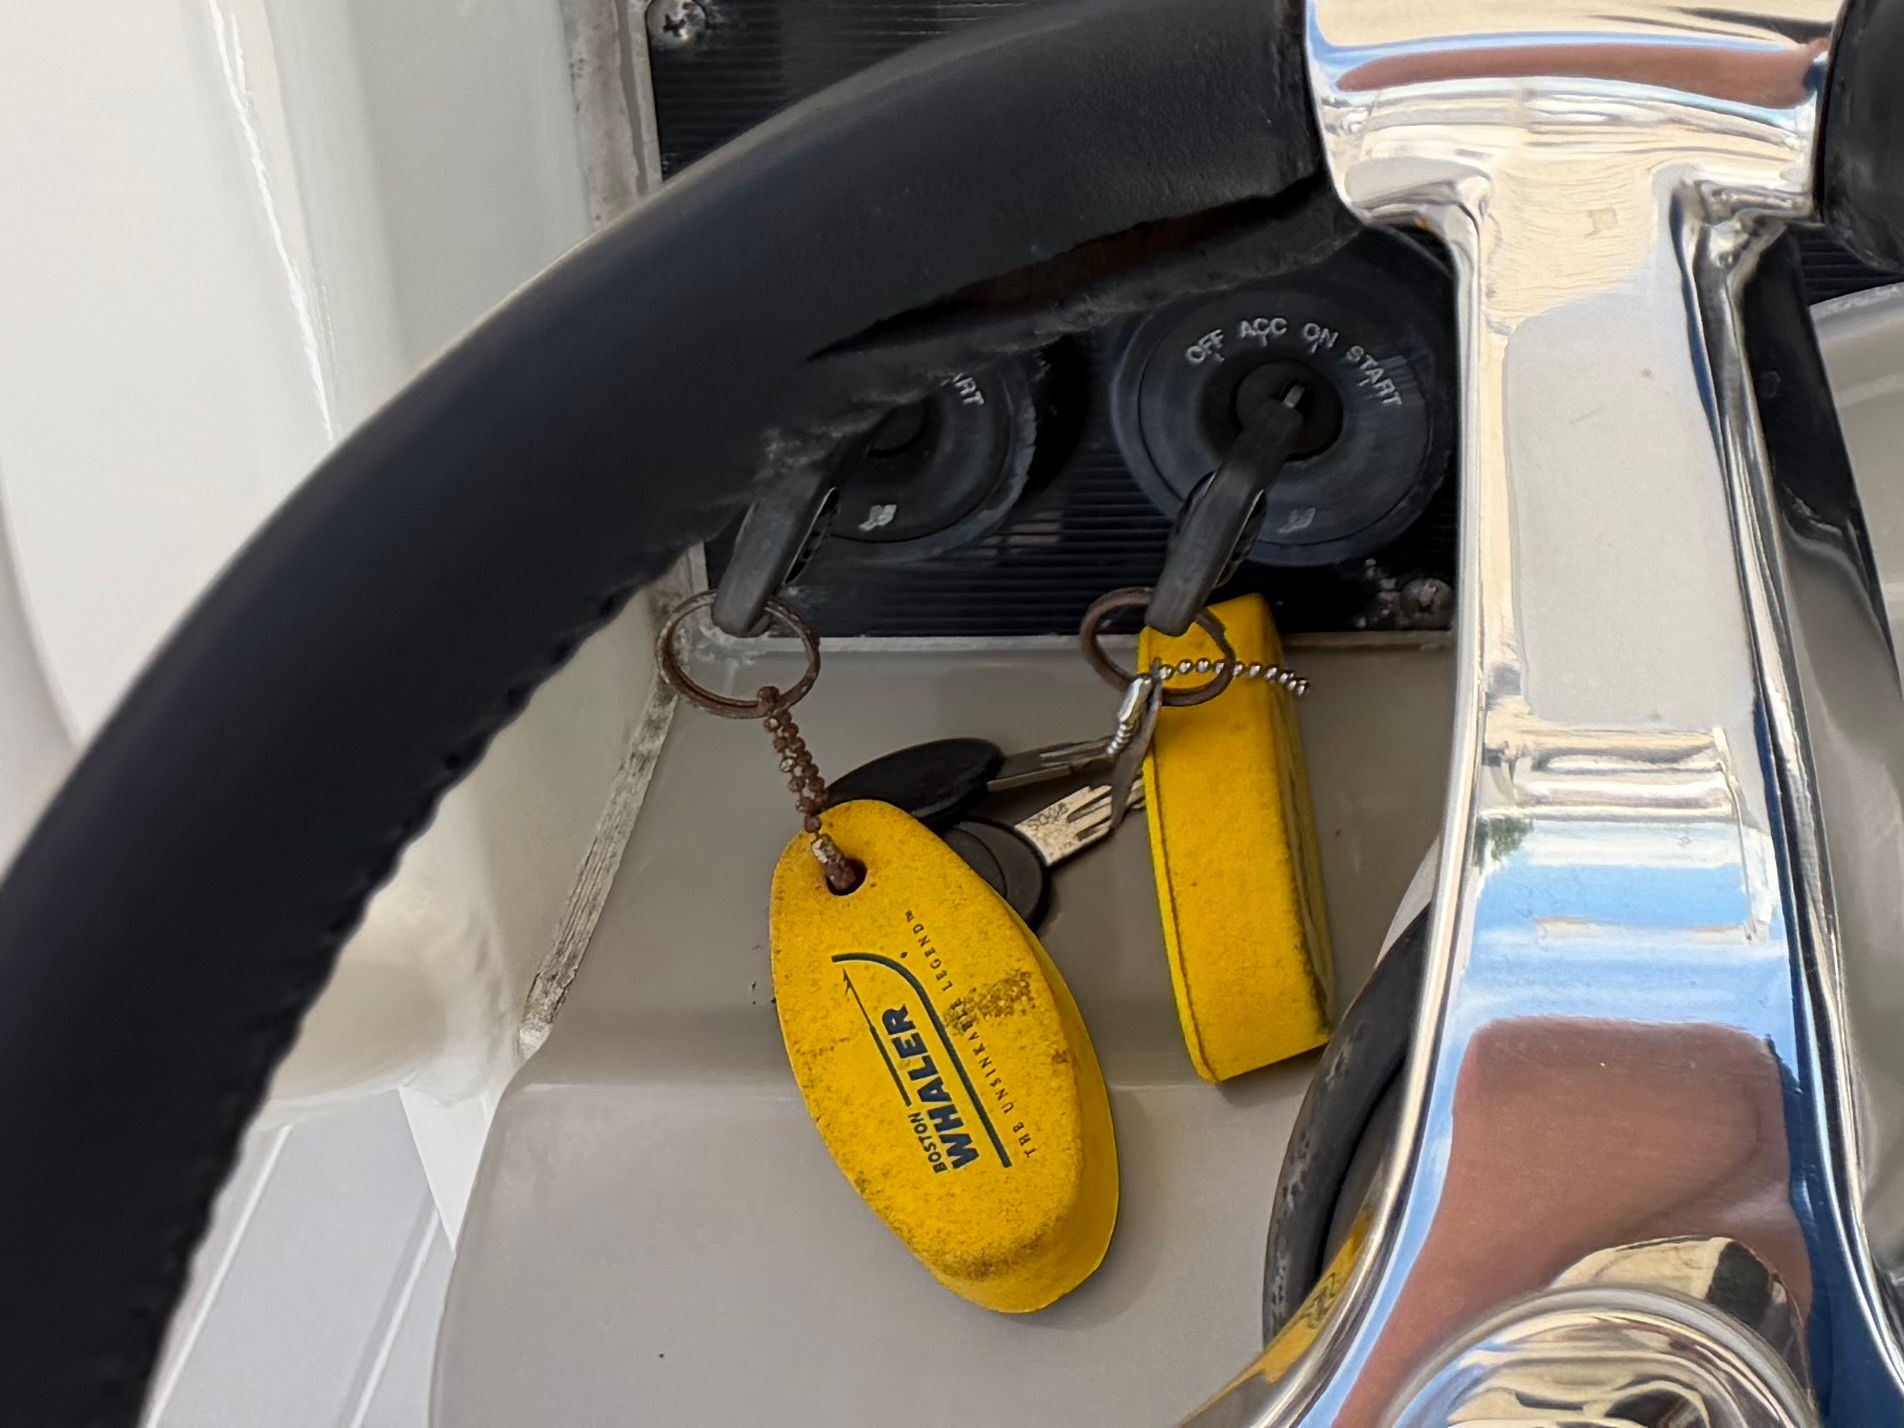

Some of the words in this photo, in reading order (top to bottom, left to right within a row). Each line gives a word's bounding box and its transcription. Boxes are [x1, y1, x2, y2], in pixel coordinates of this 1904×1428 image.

[1185, 328, 1225, 364] OFF
[1239, 317, 1288, 339] ACC
[1303, 322, 1339, 349] ON
[1346, 345, 1402, 406] START
[881, 1003, 980, 1170] WHALER
[907, 1112, 948, 1174] BOSTON
[1012, 1121, 1038, 1159] THE
